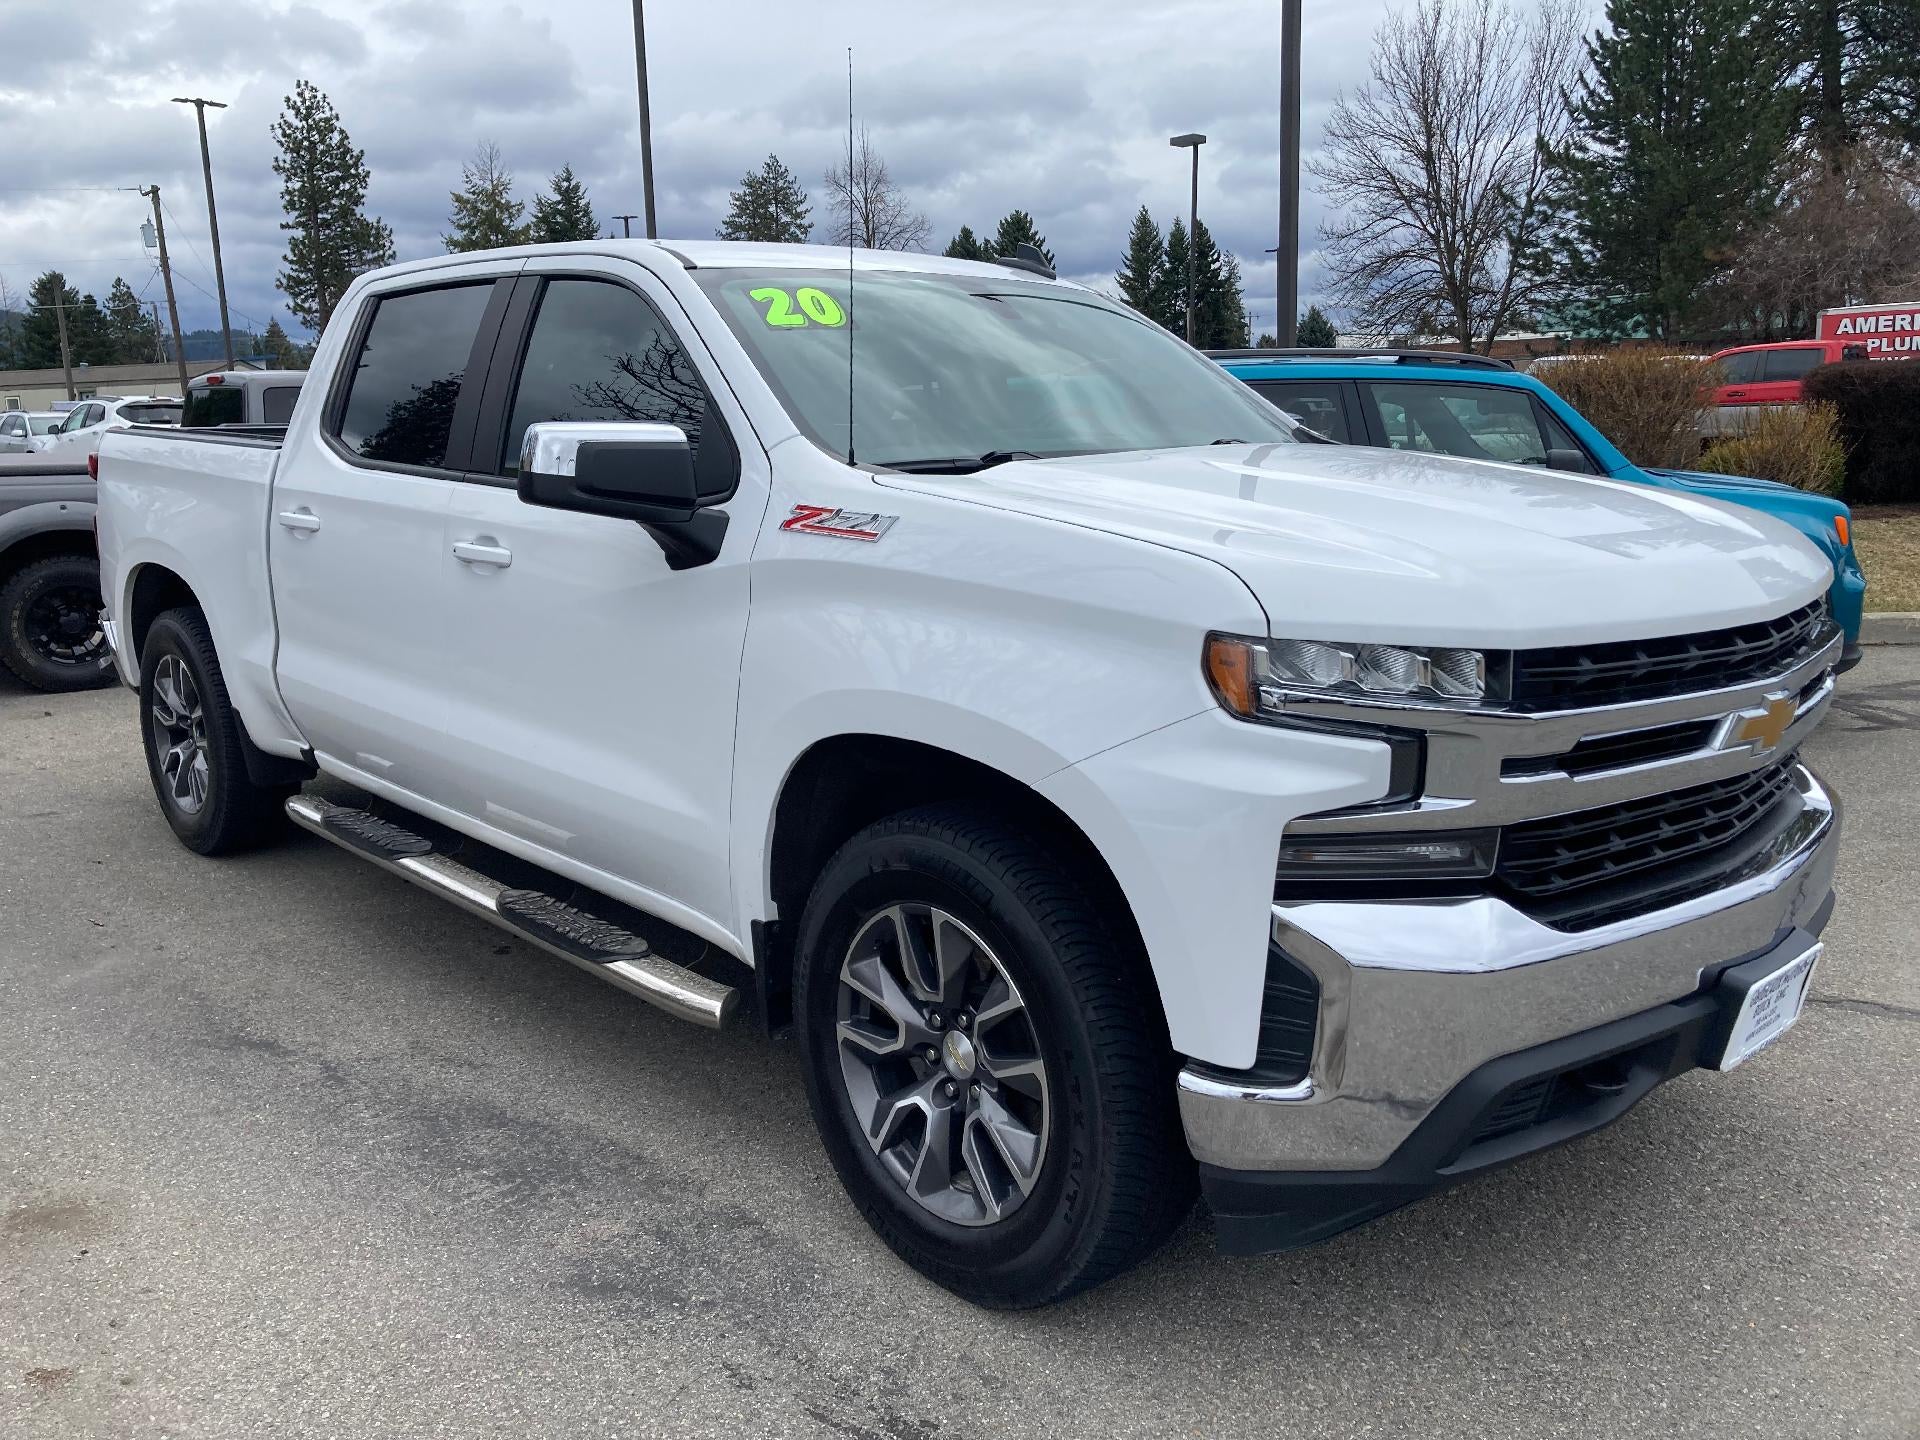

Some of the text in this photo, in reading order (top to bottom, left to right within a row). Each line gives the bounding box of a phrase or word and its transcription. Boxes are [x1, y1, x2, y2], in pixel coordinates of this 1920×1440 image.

[749, 287, 847, 328] 20
[1835, 313, 1920, 335] AMERI
[779, 503, 900, 543] Z71
